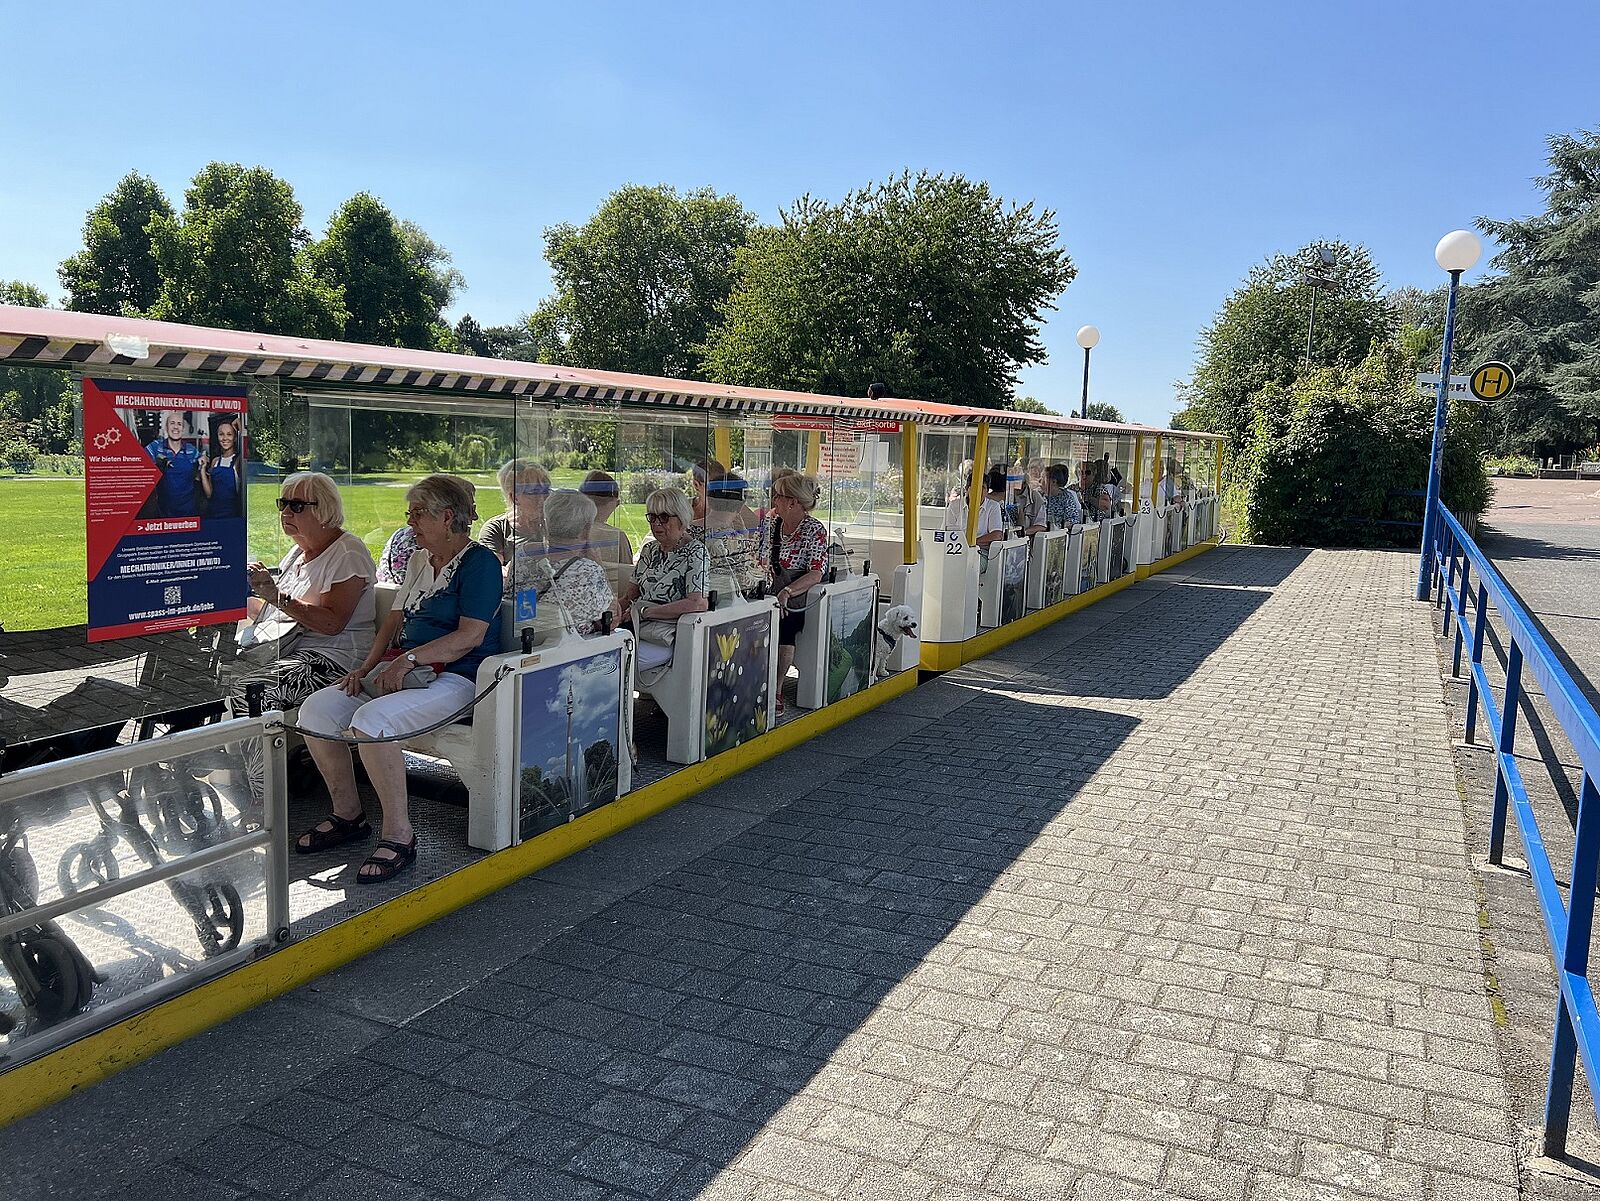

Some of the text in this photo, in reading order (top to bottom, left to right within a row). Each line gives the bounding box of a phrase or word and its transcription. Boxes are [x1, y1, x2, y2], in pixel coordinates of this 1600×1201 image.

[1480, 370, 1503, 393] H
[115, 395, 241, 411] MECHATRONIKER/INNEN (M/W/D)
[122, 455, 142, 463] Ihnen:
[1141, 506, 1151, 515] 23
[144, 520, 198, 532] Jetzt bewerben
[946, 542, 962, 555] 22
[128, 601, 215, 621] www.spass-im-park.de/jobs
